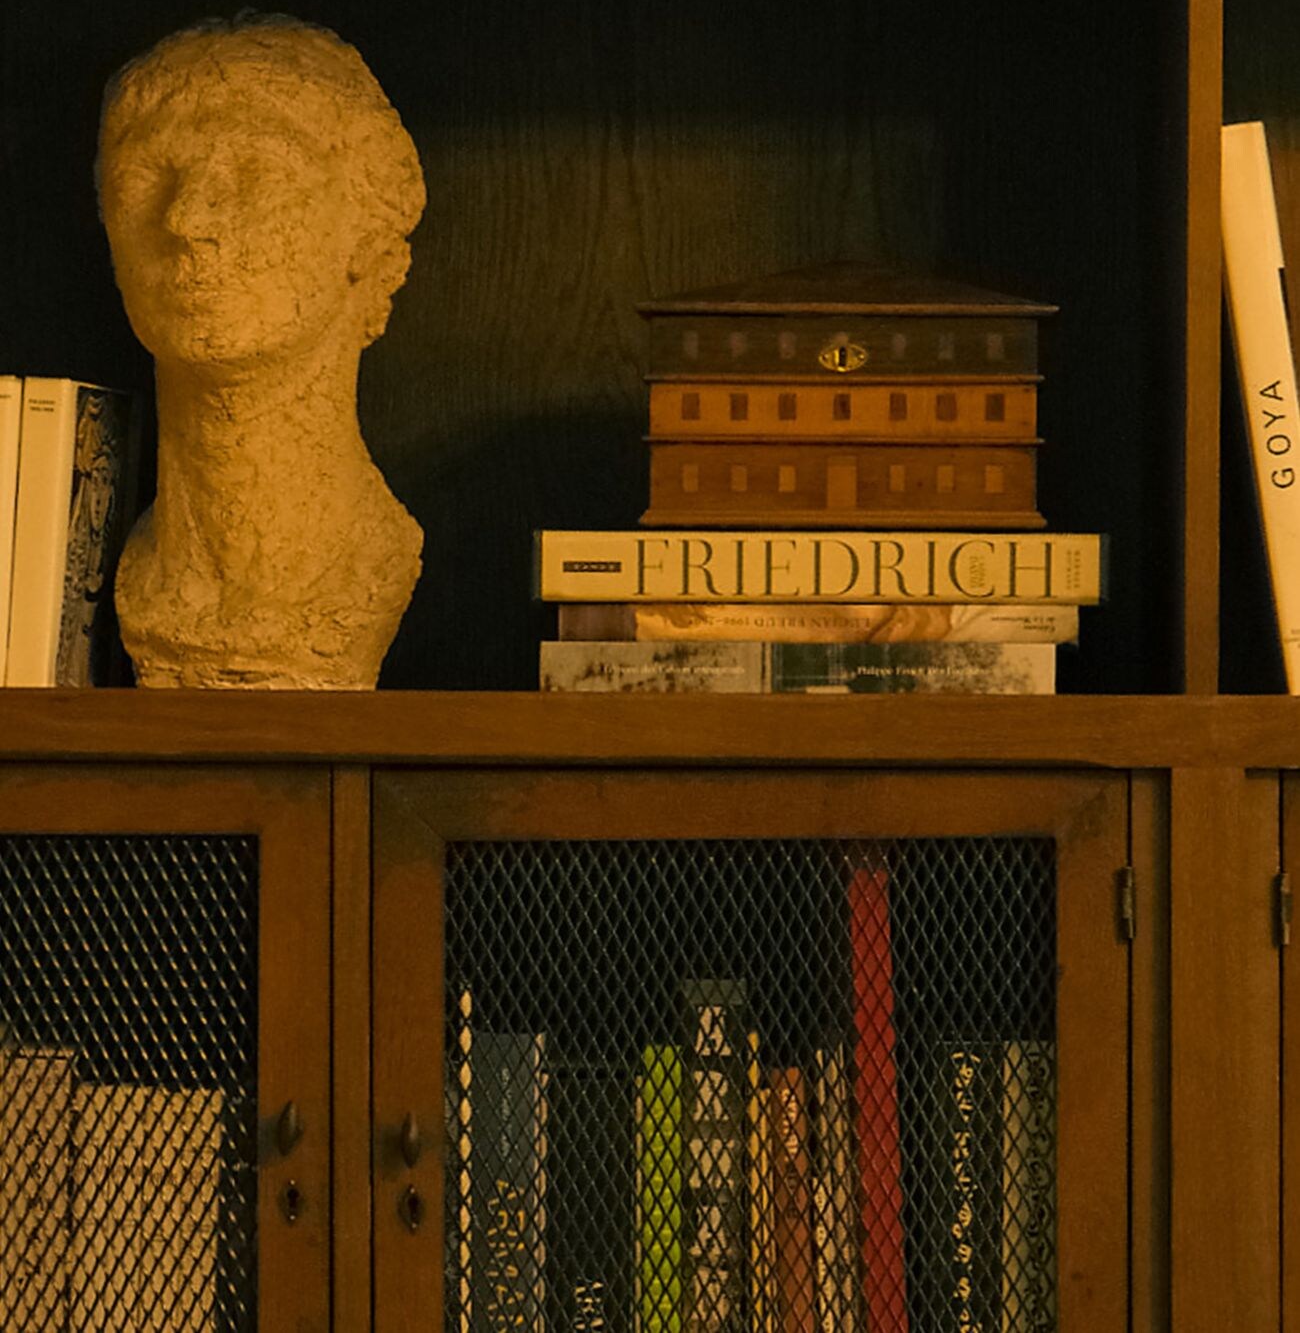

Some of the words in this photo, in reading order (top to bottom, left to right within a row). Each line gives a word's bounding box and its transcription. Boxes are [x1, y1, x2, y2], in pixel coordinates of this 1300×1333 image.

[1258, 379, 1296, 489] GOYA
[634, 538, 1057, 599] FRIEDRICH
[754, 618, 806, 629] FREUD
